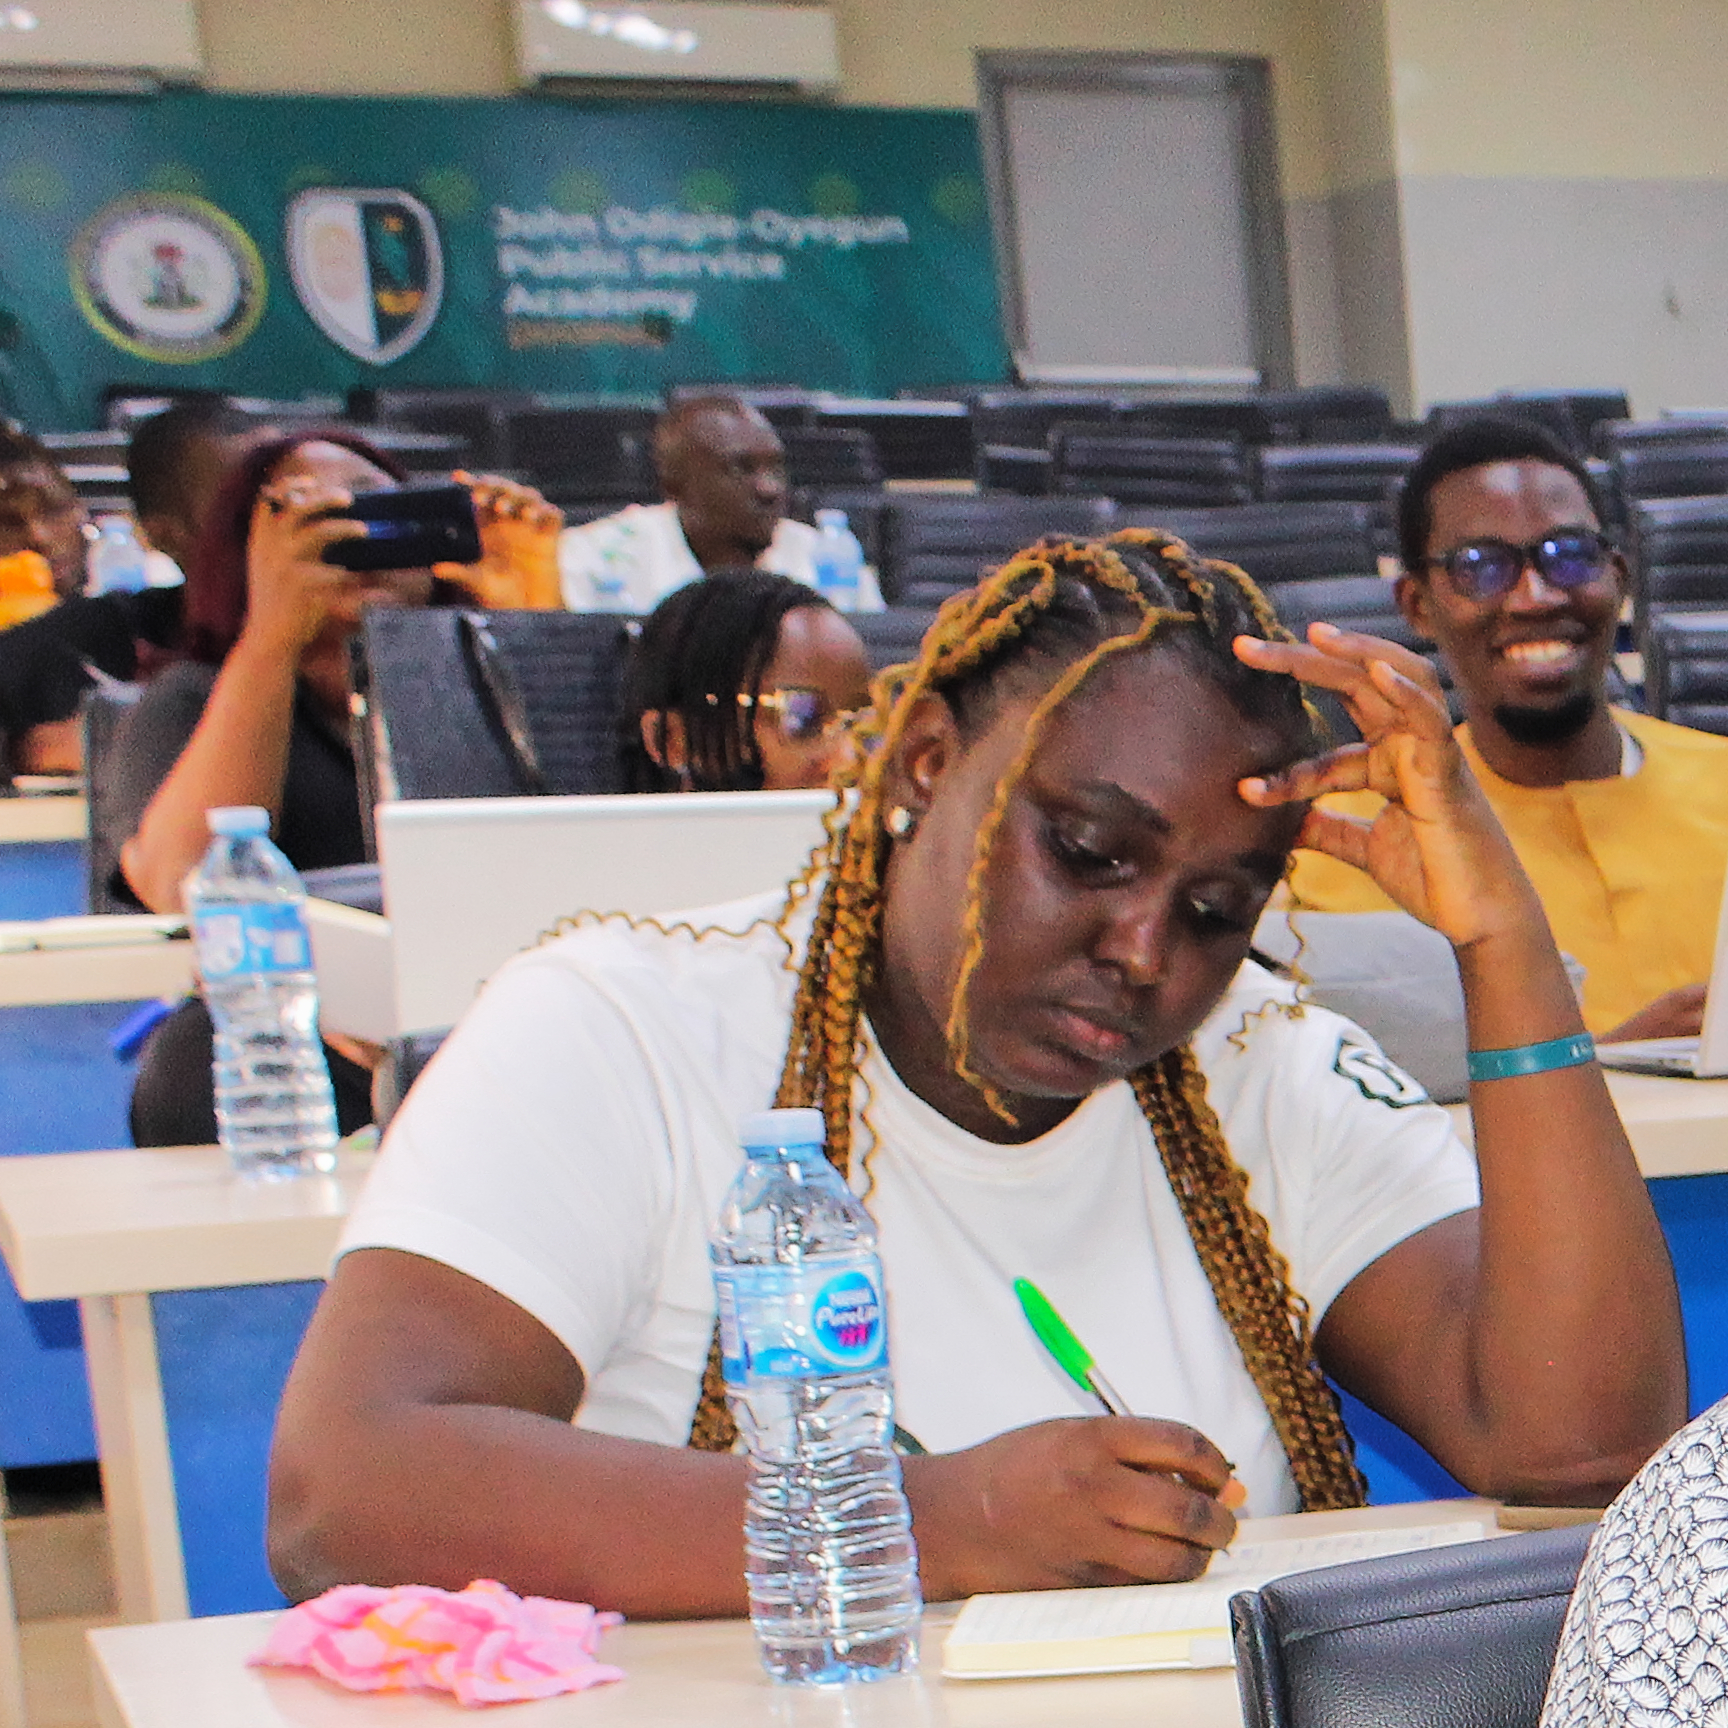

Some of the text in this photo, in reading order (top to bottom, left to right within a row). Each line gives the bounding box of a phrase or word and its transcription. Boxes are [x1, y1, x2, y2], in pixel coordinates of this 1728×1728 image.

[494, 205, 597, 240] John
[498, 246, 785, 280] Public Service
[504, 286, 698, 322] Academy
